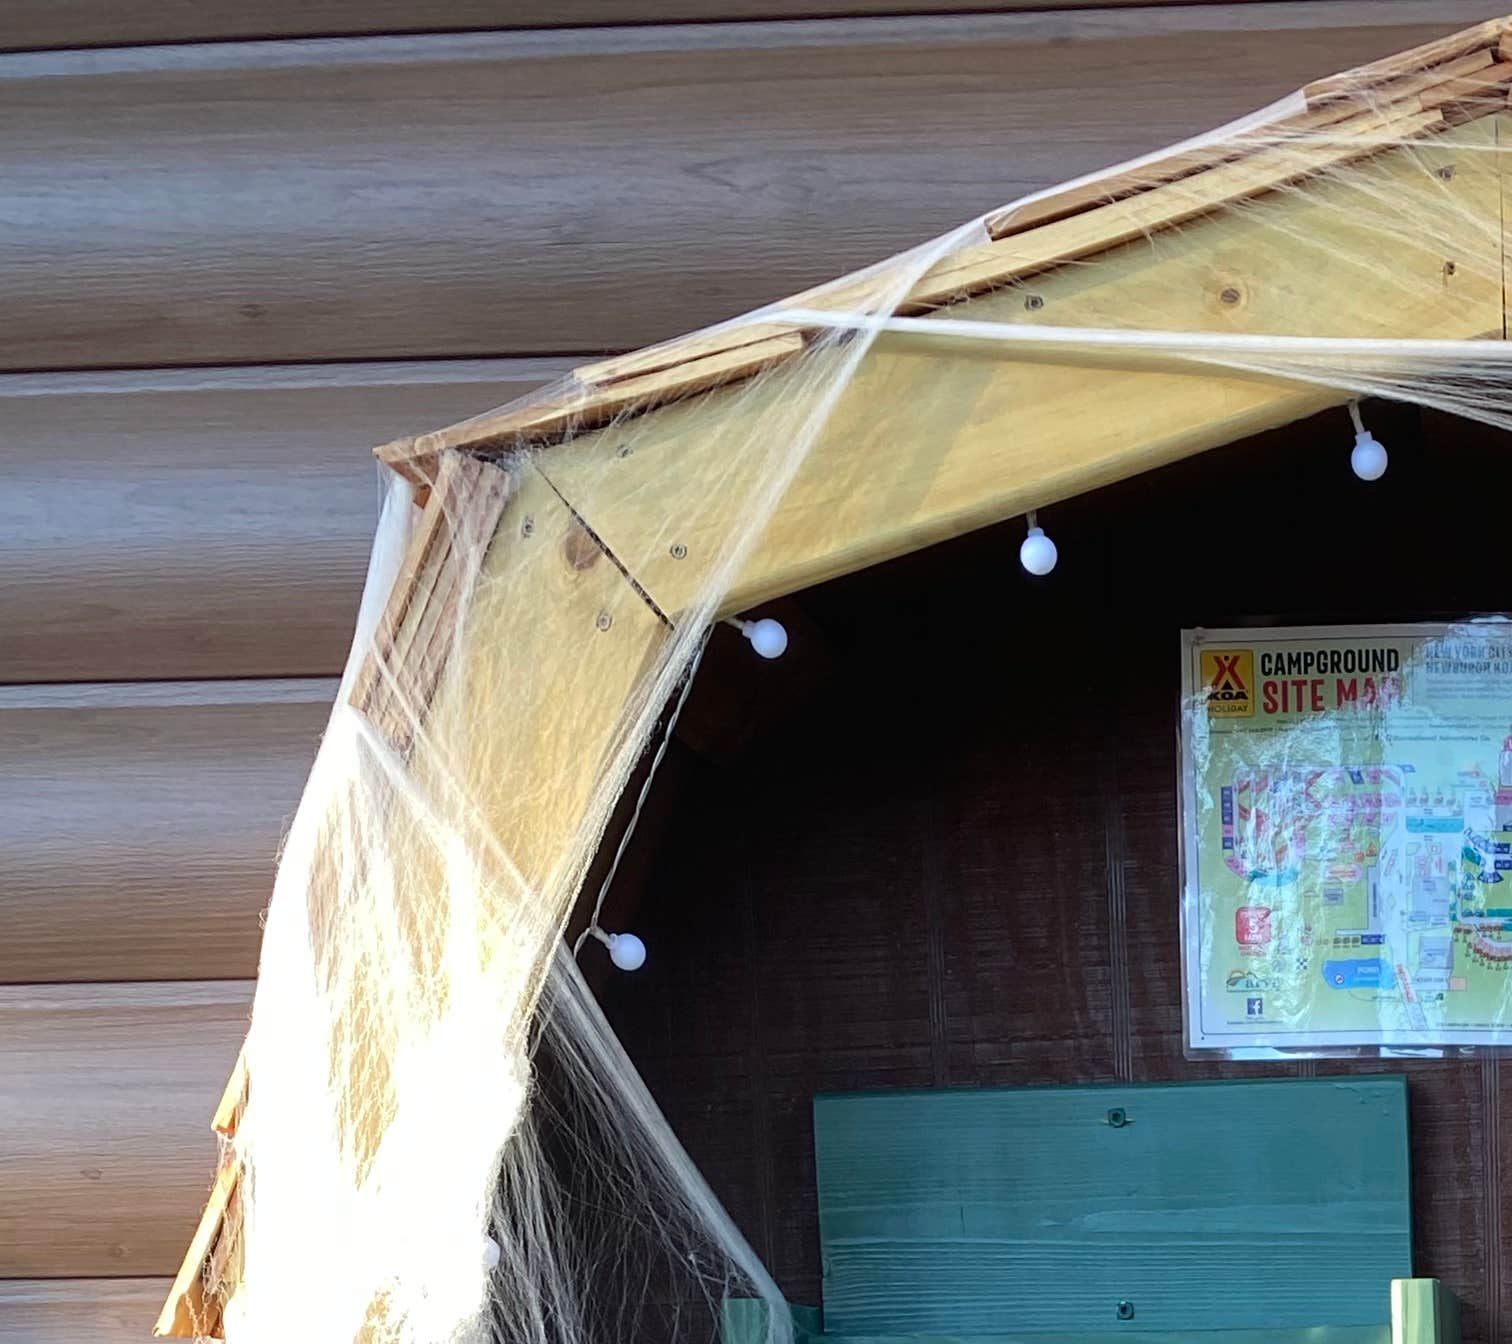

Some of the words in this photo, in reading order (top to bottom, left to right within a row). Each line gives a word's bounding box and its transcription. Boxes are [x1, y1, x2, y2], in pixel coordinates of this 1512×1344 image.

[1261, 648, 1399, 676] CAMPGROUND
[1207, 691, 1248, 701] KOA
[1263, 679, 1325, 714] SITE
[1337, 676, 1400, 711] MAP
